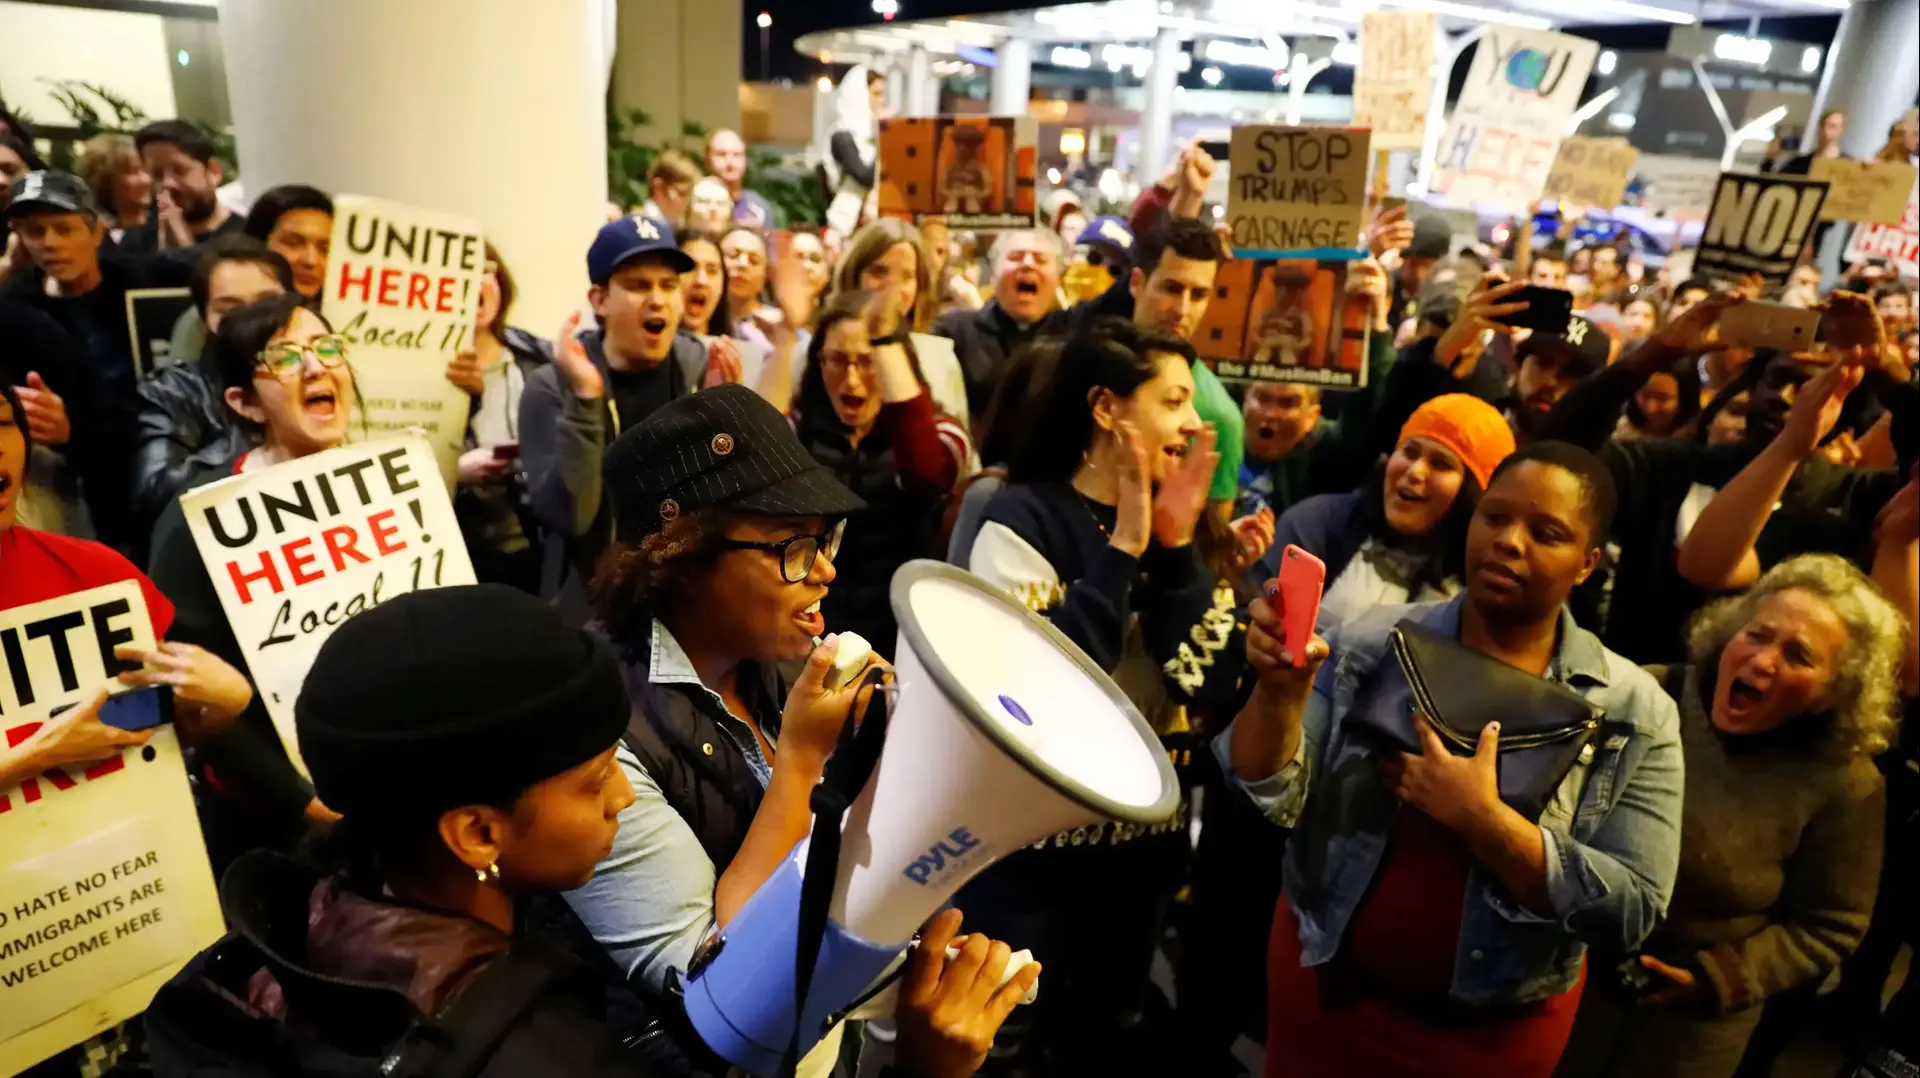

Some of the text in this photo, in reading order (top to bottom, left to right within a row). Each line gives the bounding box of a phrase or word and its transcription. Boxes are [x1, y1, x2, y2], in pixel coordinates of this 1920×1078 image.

[1254, 130, 1353, 174] STOP
[346, 213, 477, 271] UNITE
[1231, 214, 1351, 249] CARNAGE
[1704, 179, 1823, 259] NO!
[338, 261, 469, 315] HERE!
[341, 310, 431, 350] Local
[203, 447, 419, 548] UNITE
[225, 498, 432, 605] HERE!
[258, 599, 387, 651] Local
[0, 598, 144, 715] ITE
[902, 825, 981, 885] PYLE
[13, 886, 71, 921] HATE
[75, 872, 107, 896] NO
[111, 850, 159, 881] FEAR
[130, 878, 165, 905] ARE
[1, 907, 163, 988] WELCOME HERE
